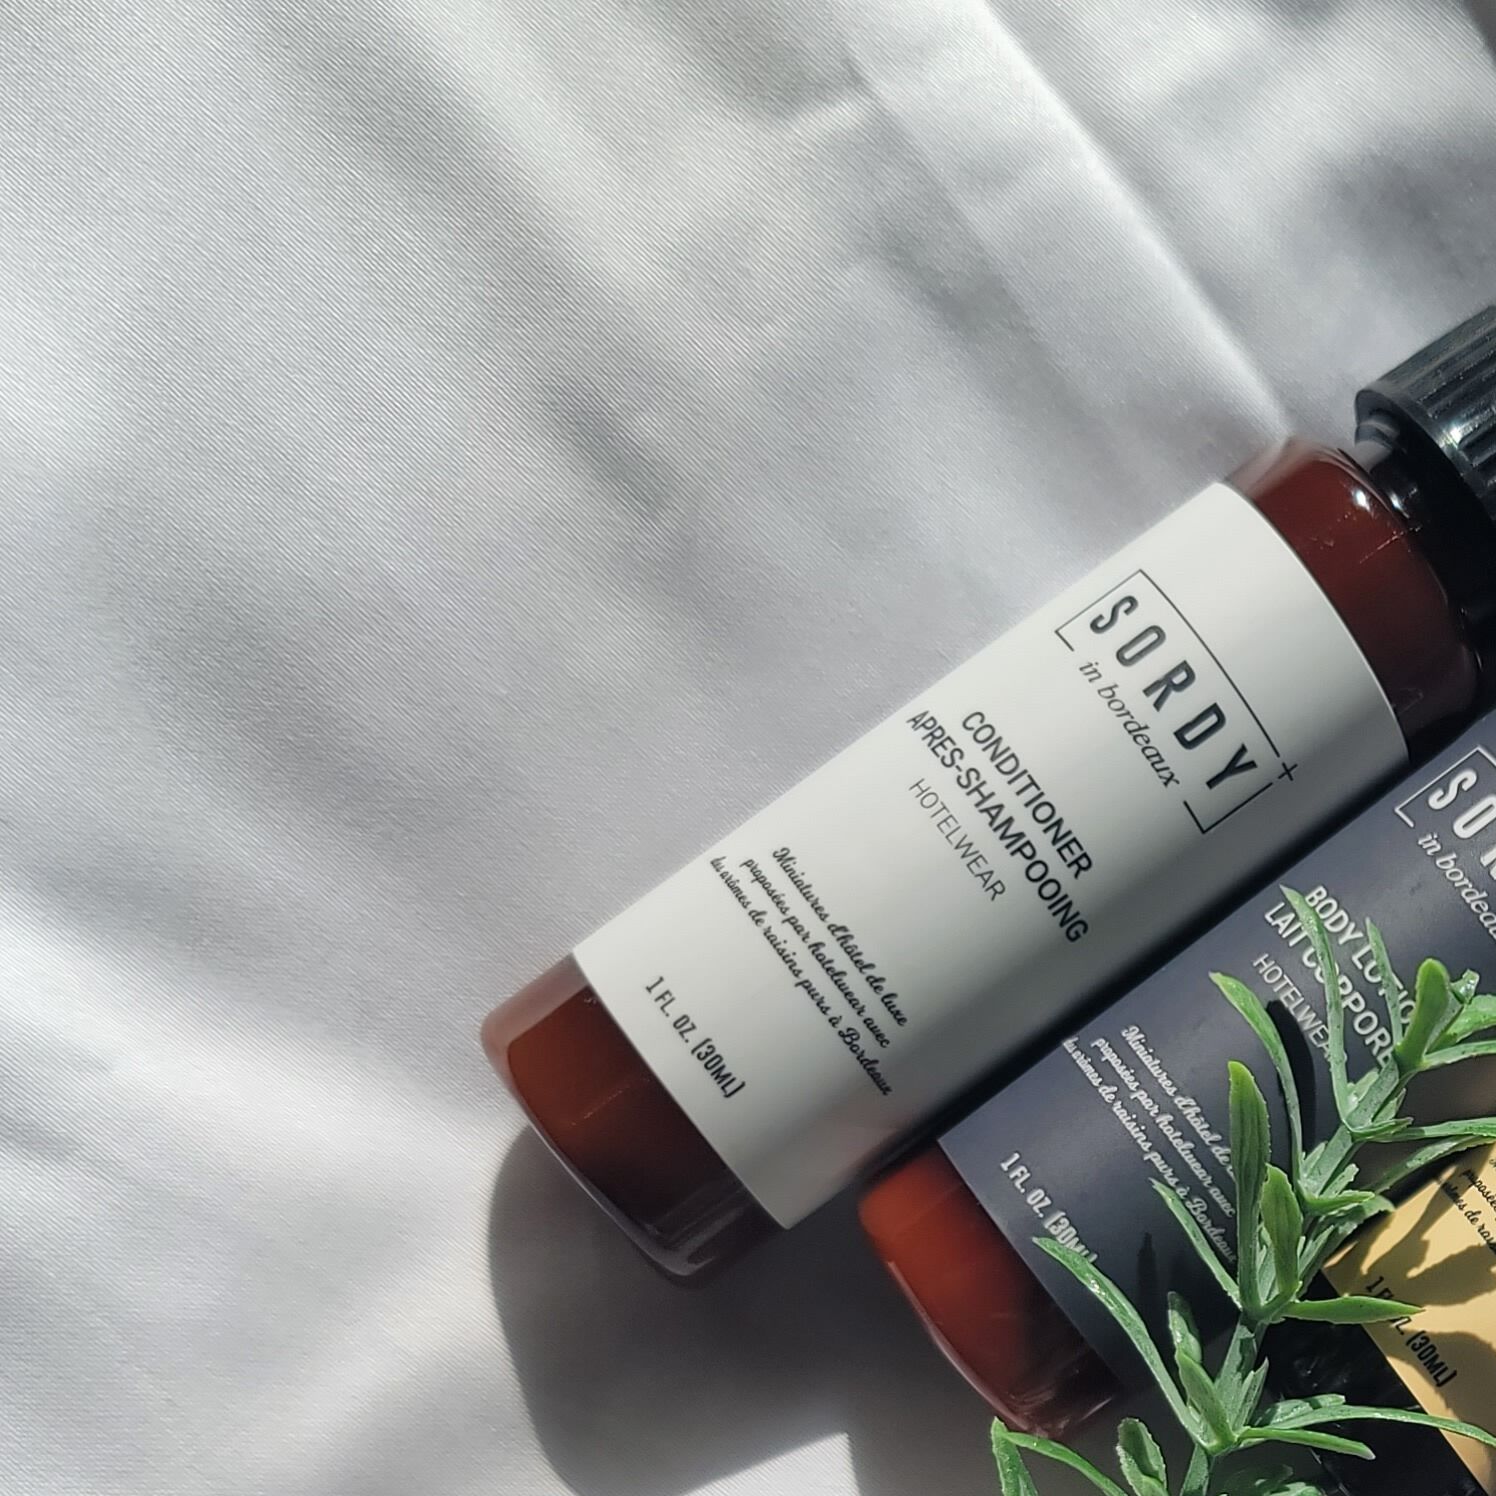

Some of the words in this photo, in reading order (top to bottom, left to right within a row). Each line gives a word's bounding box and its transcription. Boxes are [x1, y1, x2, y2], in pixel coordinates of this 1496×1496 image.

[1078, 661, 1103, 683] in
[1097, 684, 1181, 788] bordeaux
[1089, 595, 1258, 790] SORDY
[906, 710, 1088, 942] APRES-SHAMPOOING
[908, 778, 1006, 901] HOTELWEAR
[962, 711, 1093, 880] CONDITIONER
[1417, 832, 1441, 856] in
[739, 858, 791, 916] proposées
[781, 914, 810, 944] par
[808, 941, 866, 1018] hotelwear
[862, 1014, 891, 1049] avec
[772, 847, 829, 922] Miniatures
[866, 973, 886, 996] de
[881, 993, 908, 1027] luxe
[1264, 902, 1309, 947] LAIT
[1305, 885, 1364, 945] BODY
[645, 975, 664, 993] 1
[653, 989, 676, 1017] FL.
[672, 1014, 697, 1043] OZ.
[748, 909, 768, 927] de
[763, 925, 802, 980] raisins
[794, 977, 831, 1016] purs
[828, 1014, 842, 1029] à
[838, 1026, 893, 1096] Bordeaux
[1252, 953, 1347, 1062] HOTELWE
[1091, 1038, 1139, 1091] proposées
[1130, 1090, 1158, 1117] par
[1156, 1114, 1214, 1188] hotelwear
[1209, 1185, 1235, 1218] avec
[1121, 1025, 1178, 1097] Miniatures
[1211, 1144, 1232, 1166] de
[1000, 1152, 1020, 1171] 1
[1009, 1165, 1031, 1193] FL.
[1026, 1188, 1052, 1218] OZ.
[1098, 1085, 1118, 1103] de
[1112, 1100, 1152, 1152] raisins
[1143, 1151, 1180, 1187] purs
[1176, 1186, 1190, 1199] à
[1186, 1197, 1237, 1263] Bordeaux
[1464, 1210, 1482, 1226] de
